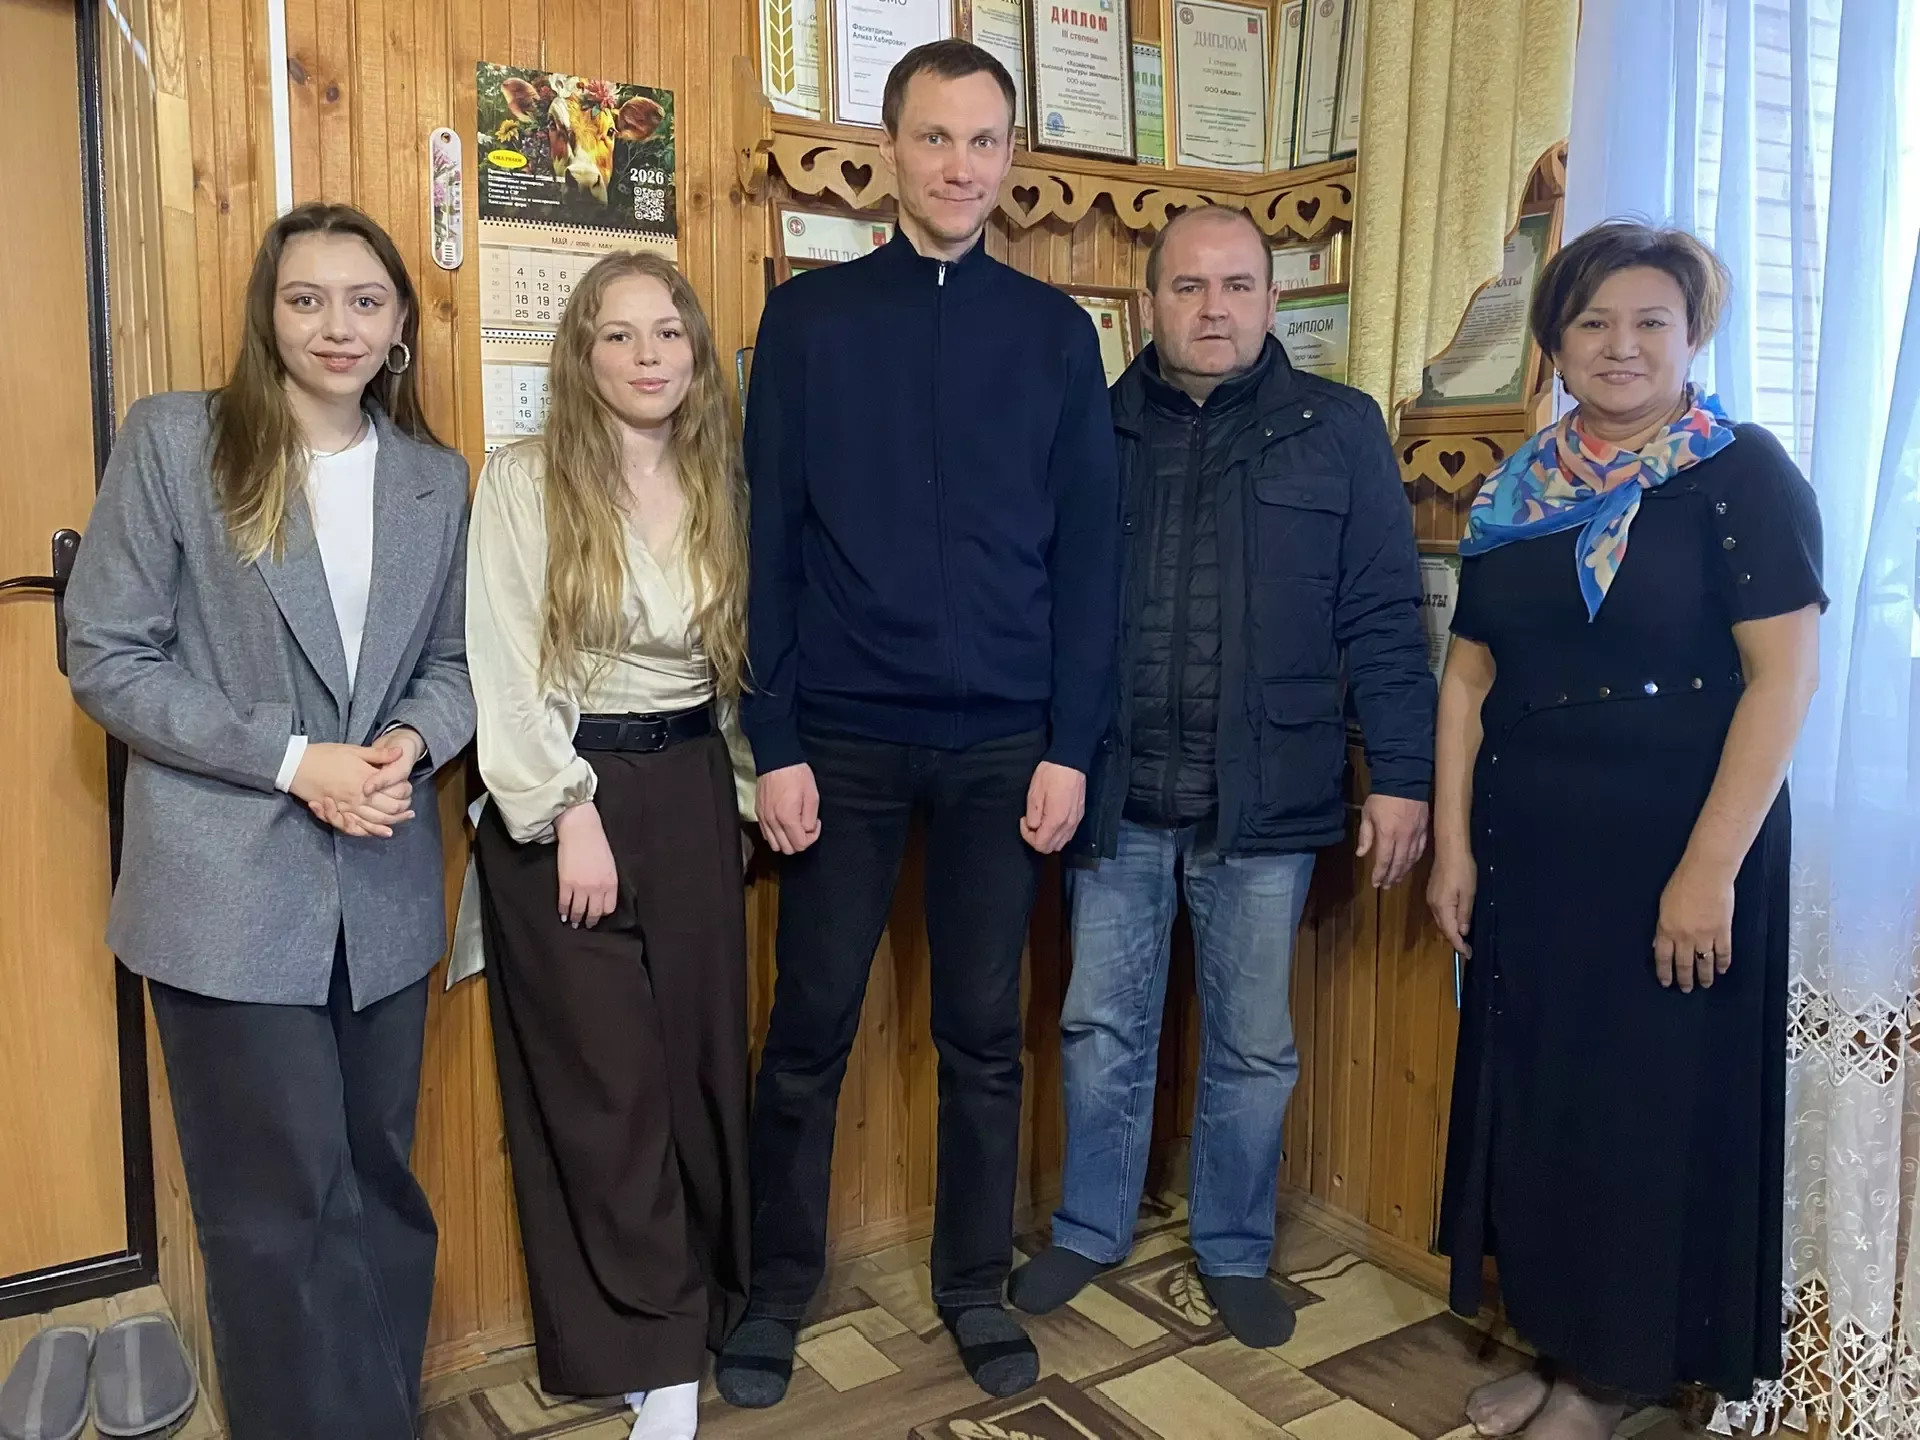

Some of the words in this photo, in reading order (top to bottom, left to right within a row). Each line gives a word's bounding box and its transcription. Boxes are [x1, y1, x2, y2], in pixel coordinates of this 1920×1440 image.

[1051, 6, 1108, 32] ДИПЛОМ
[852, 31, 872, 41] Алмаз
[873, 35, 907, 47] Хабирович
[1070, 32, 1099, 44] степени
[1193, 30, 1247, 52] ДИПЛОМ
[1066, 77, 1079, 85] ООО
[1204, 85, 1219, 94] ООО
[630, 168, 664, 185] 2026
[551, 237, 568, 245] МАЙ
[538, 269, 546, 278] 5
[560, 271, 567, 279] 6
[515, 281, 526, 289] 11
[537, 283, 549, 291] 12
[558, 285, 571, 293] 13
[516, 295, 529, 304] 18
[537, 297, 550, 306] 19
[515, 309, 529, 318] 25
[537, 311, 550, 320] 26
[1287, 318, 1334, 337] ДИПЛОМ
[520, 383, 527, 391] 2
[521, 396, 528, 404] 9
[540, 397, 552, 405] 10
[519, 410, 532, 418] 16
[515, 422, 536, 433] 23/30
